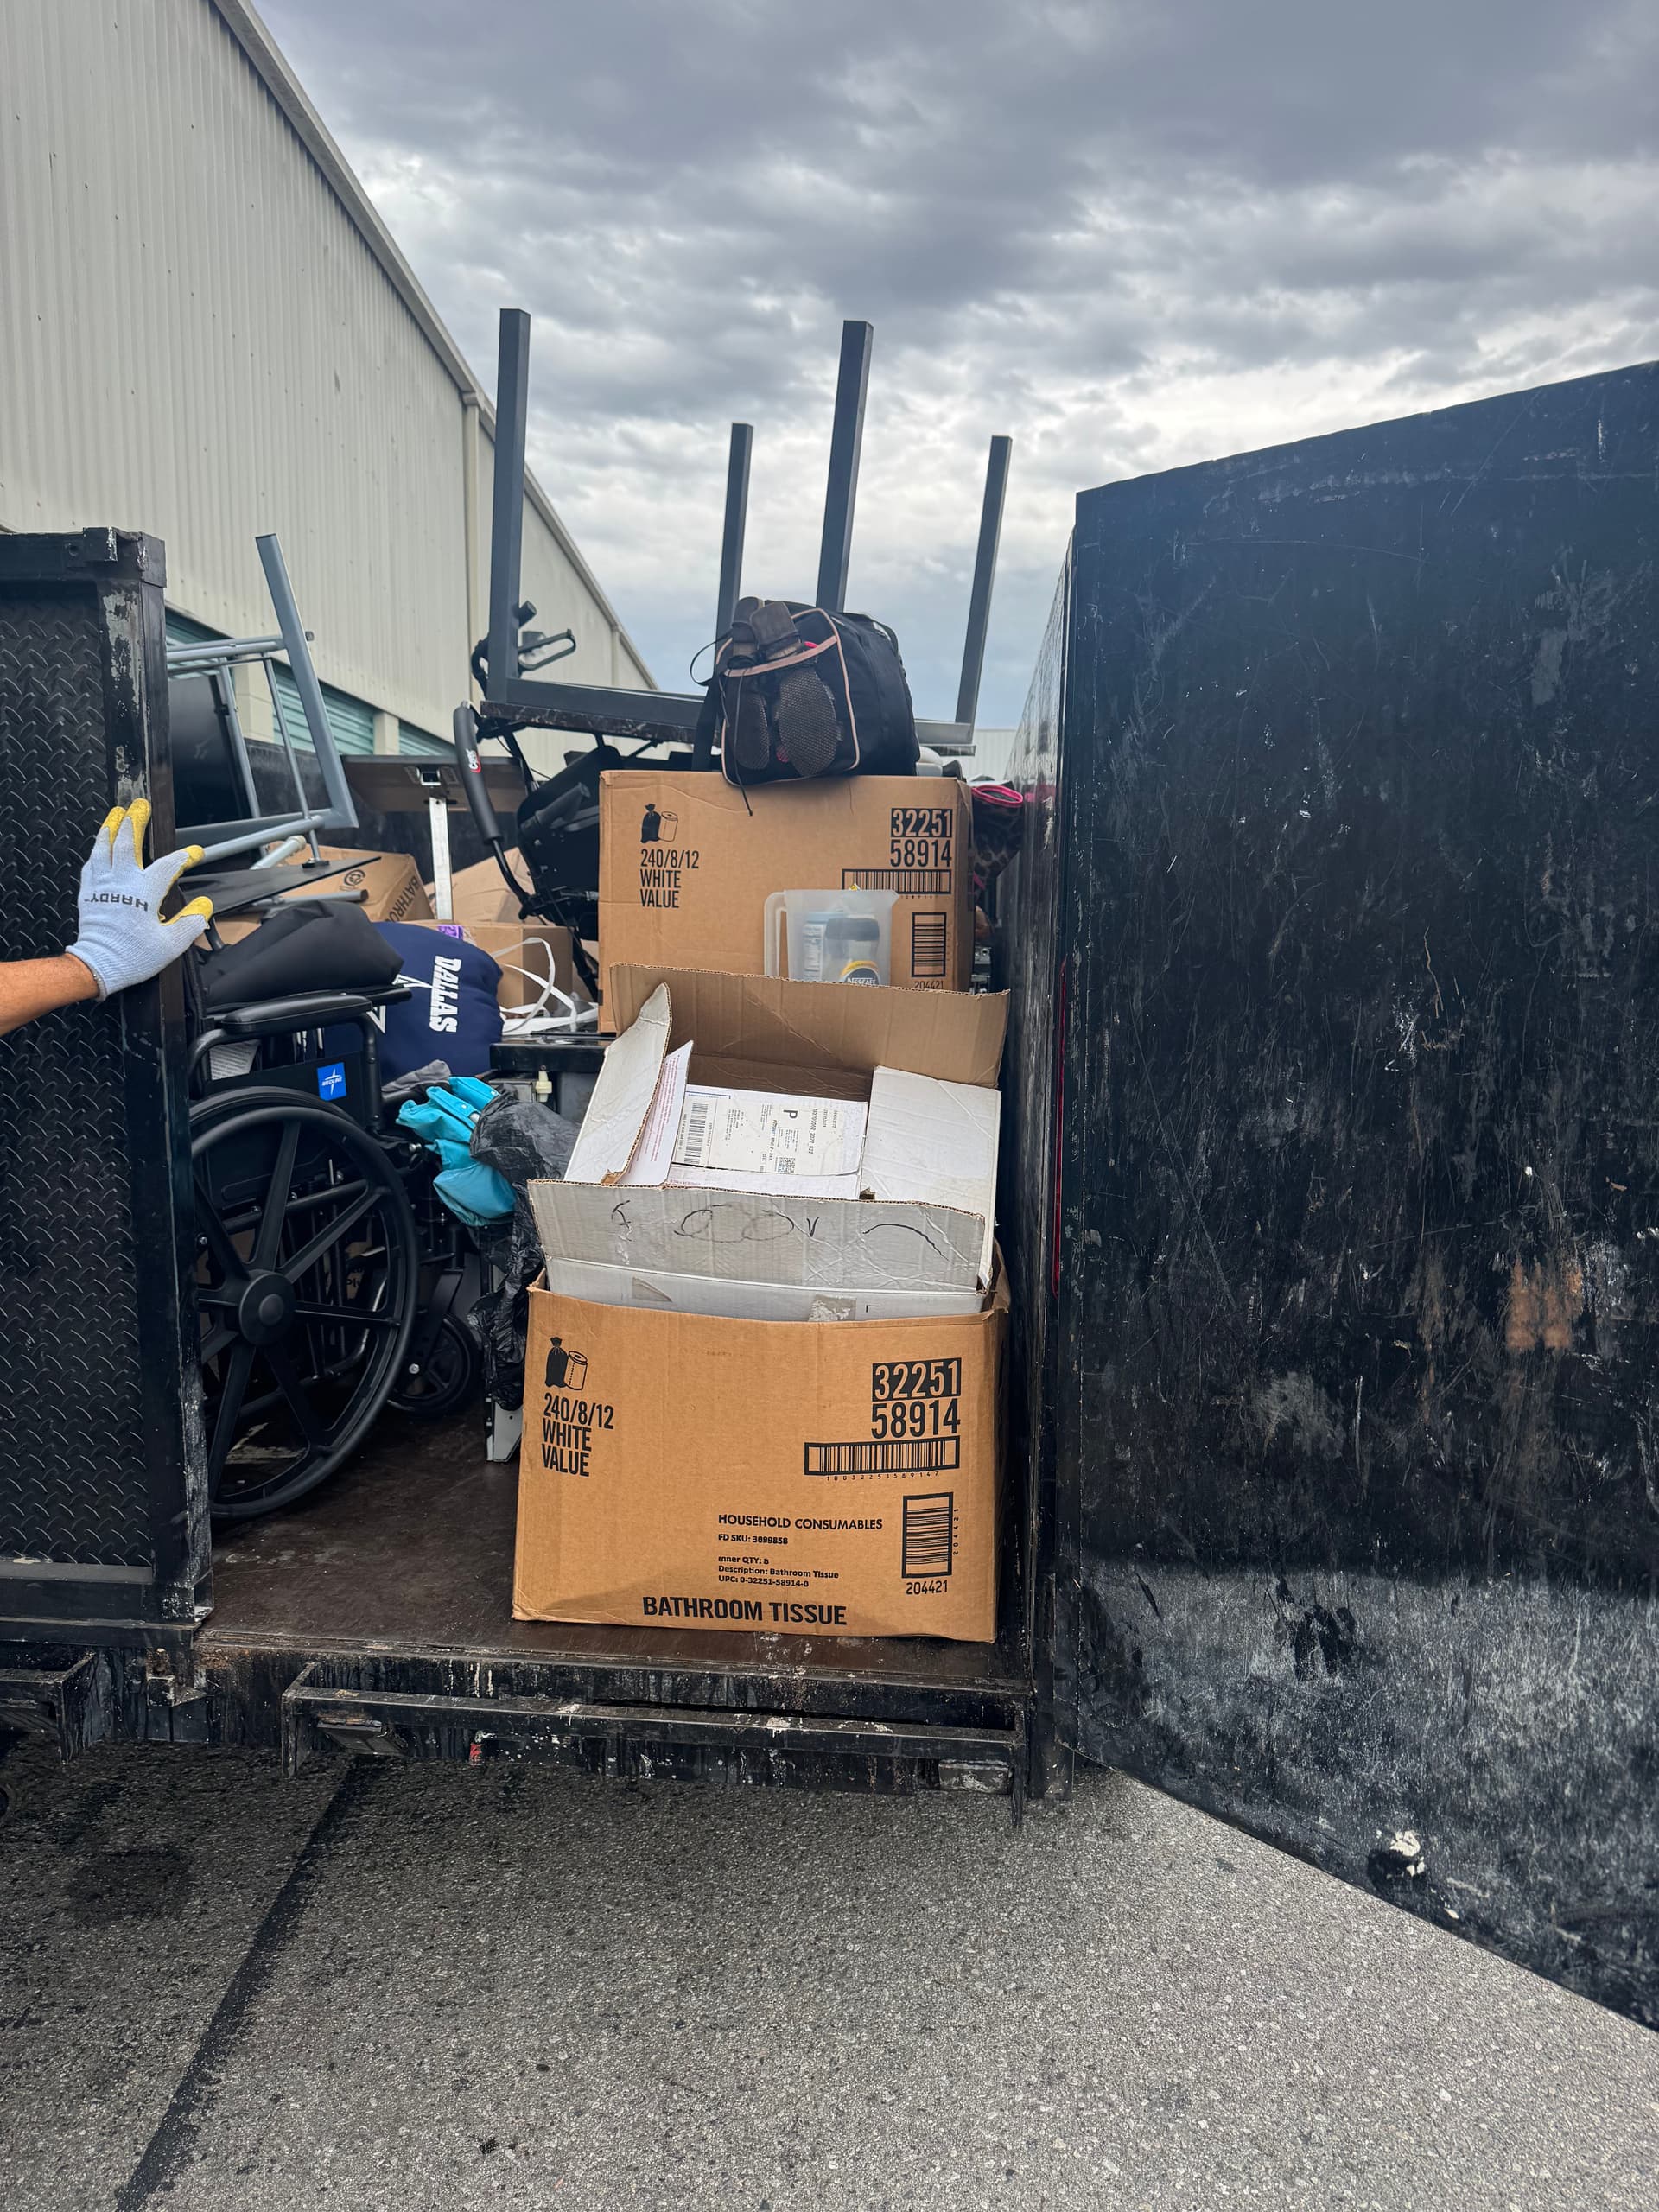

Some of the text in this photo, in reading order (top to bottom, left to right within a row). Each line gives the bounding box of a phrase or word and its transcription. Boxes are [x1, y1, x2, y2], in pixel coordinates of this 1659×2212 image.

[892, 809, 951, 836] 32251
[641, 849, 700, 869] 240/8/12
[890, 839, 952, 868] 58914
[639, 869, 681, 888] WHITE
[90, 893, 148, 912] HARDY
[385, 875, 421, 923] BATHRO
[639, 888, 679, 908] VALUE
[429, 955, 462, 1033] DALLAS
[783, 1109, 798, 1119] P
[874, 1360, 958, 1400] 32251
[543, 1393, 614, 1430] 240/8/12
[871, 1398, 961, 1439] 58914
[543, 1418, 592, 1452] WHITE
[541, 1443, 589, 1477] VALUE
[718, 1515, 883, 1530] HOUSEHOLD CONSUMABLES
[718, 1565, 768, 1575] Description:
[769, 1568, 811, 1578] Bathroom
[740, 1576, 810, 1587] 0-32251-58914-0
[906, 1580, 948, 1595] 204421
[642, 1596, 847, 1625] BATHROOM TISSUE
